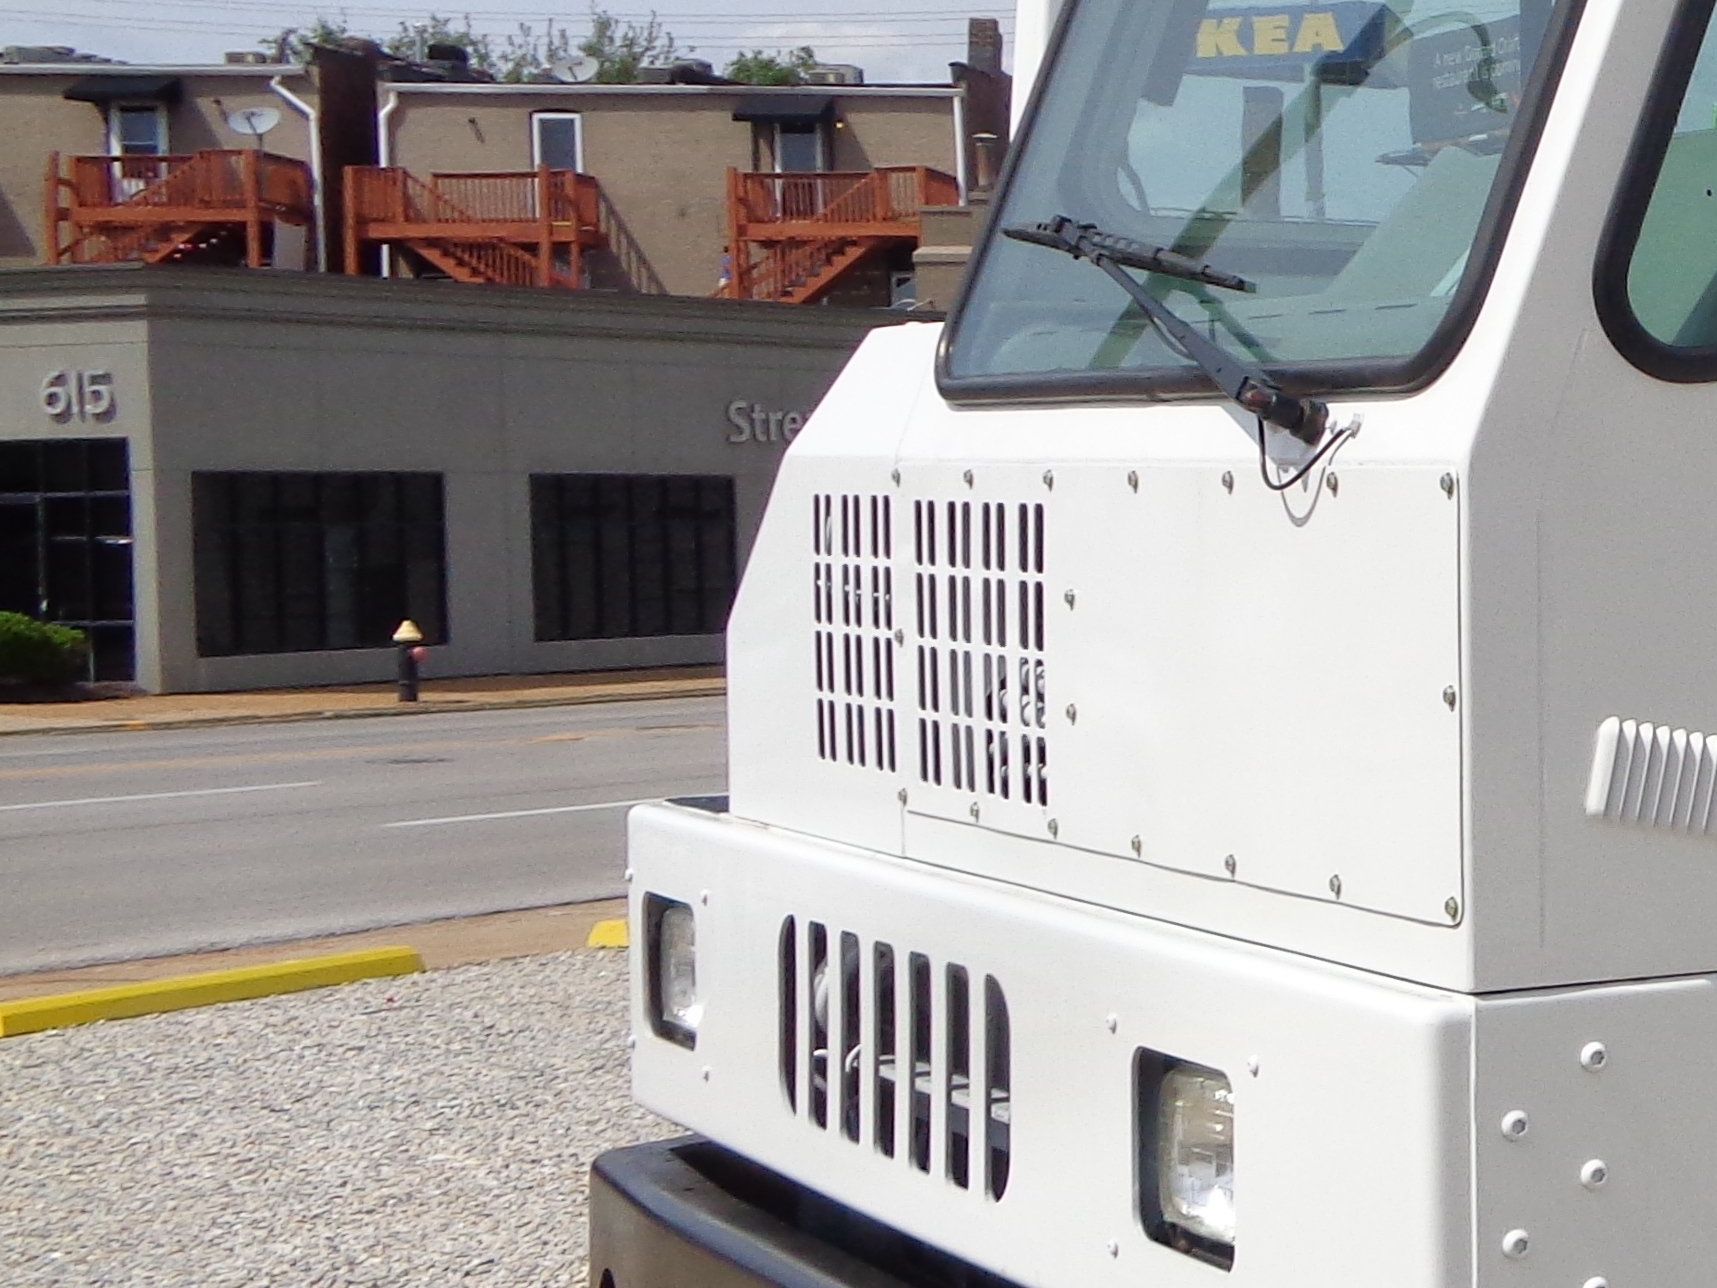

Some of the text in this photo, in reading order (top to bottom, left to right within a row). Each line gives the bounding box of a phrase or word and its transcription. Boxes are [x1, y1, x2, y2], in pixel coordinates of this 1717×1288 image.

[1195, 10, 1345, 58] KEA
[42, 370, 113, 416] 615
[725, 399, 808, 443] Stre
